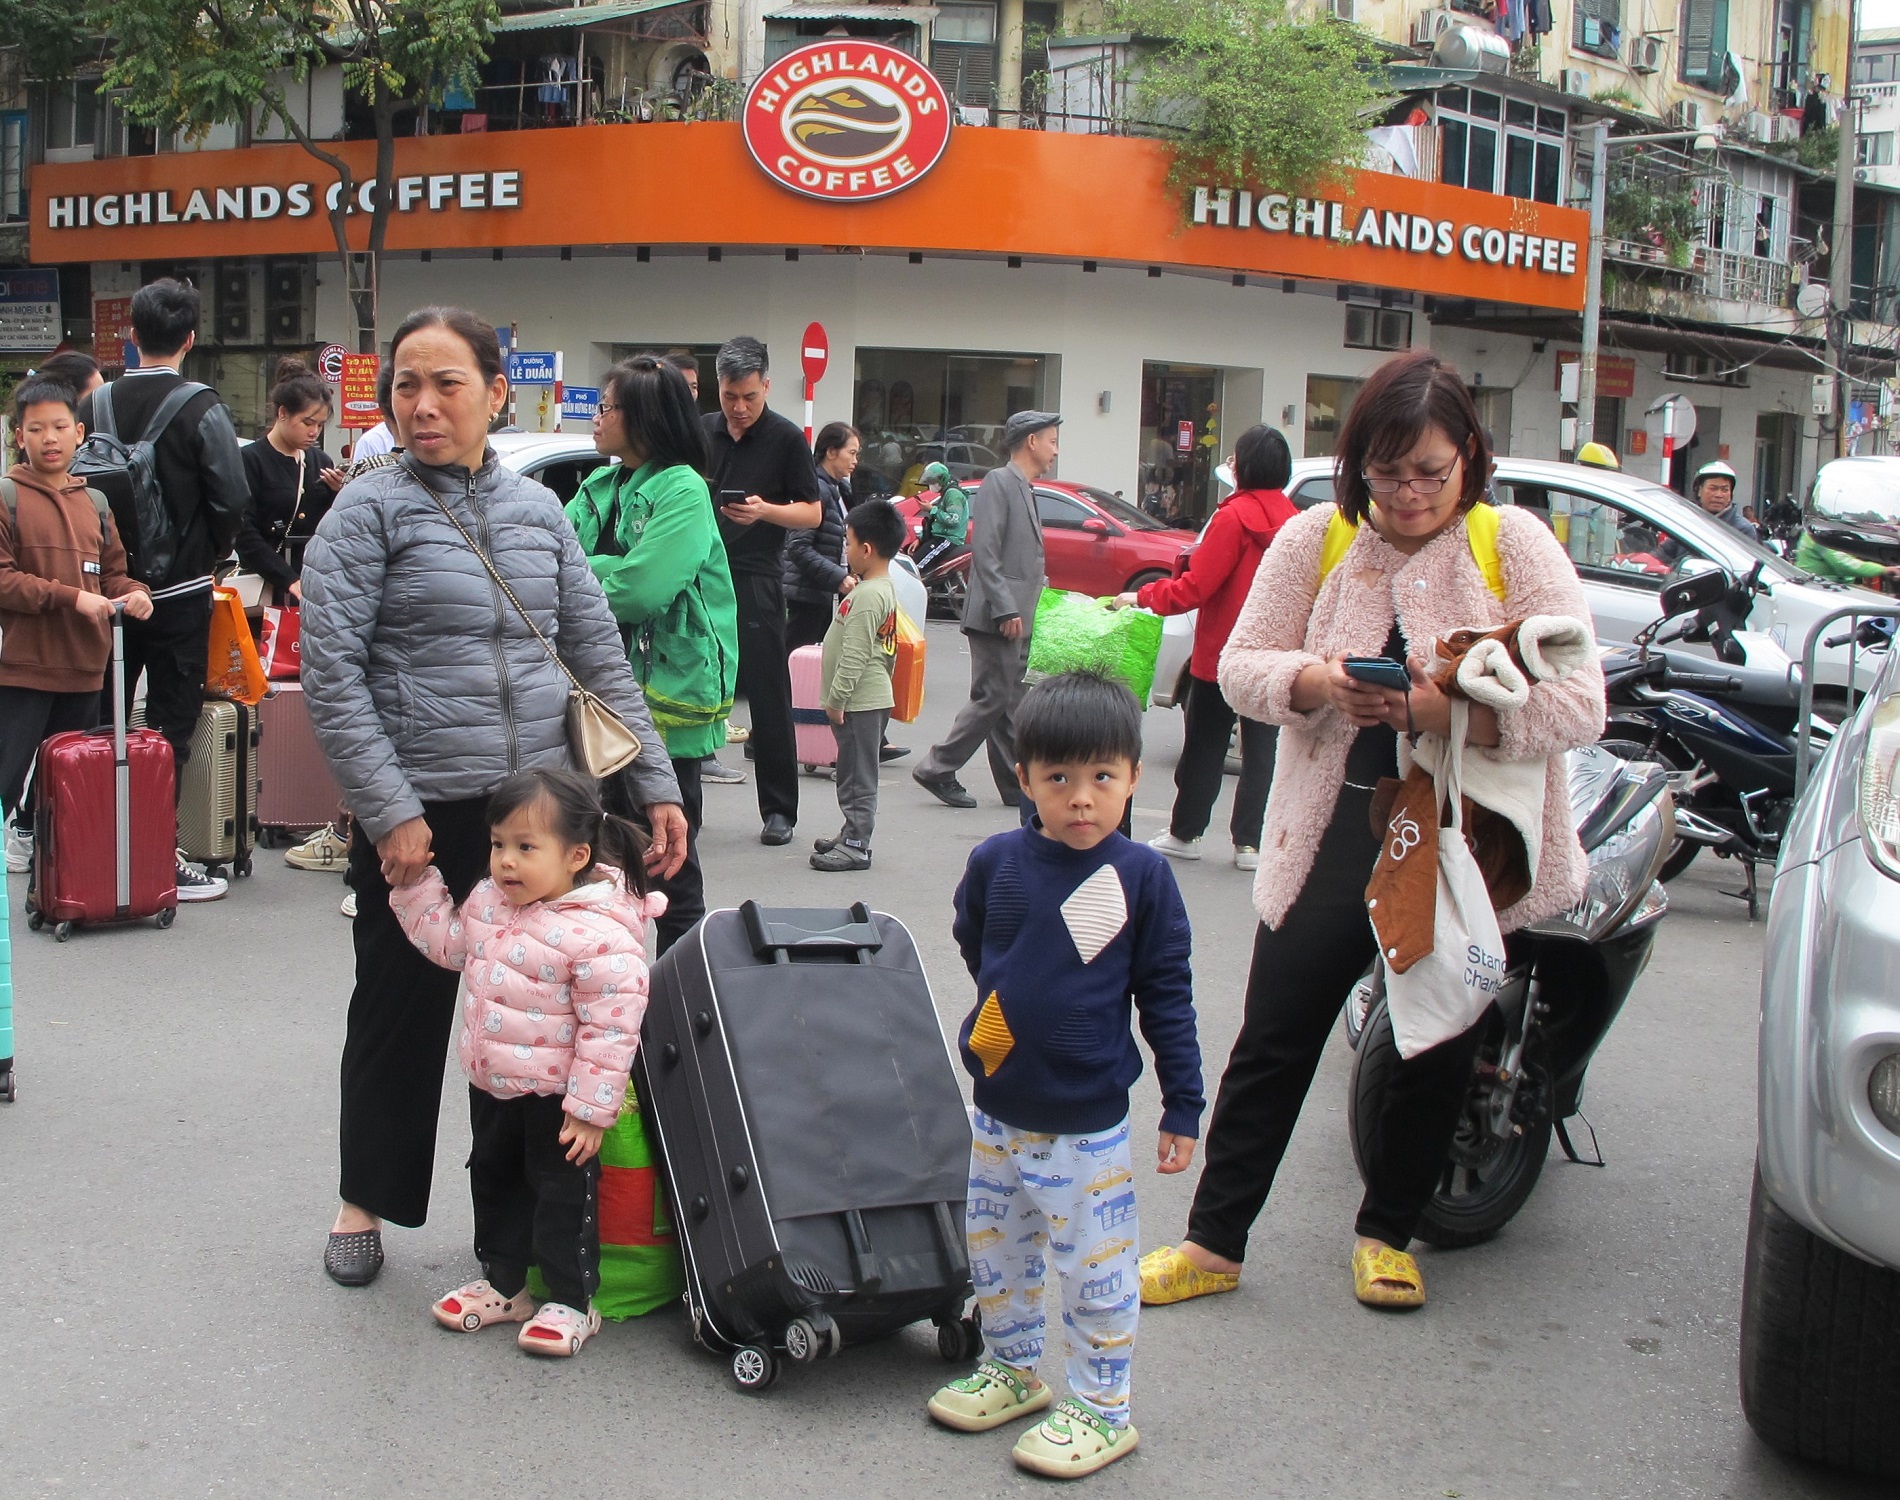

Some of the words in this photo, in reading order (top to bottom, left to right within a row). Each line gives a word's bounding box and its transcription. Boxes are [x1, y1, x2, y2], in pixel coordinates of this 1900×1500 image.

[756, 51, 939, 115] HIGHLANDS
[777, 153, 917, 192] COFFEE
[48, 182, 311, 229] HIGHLANDS
[1193, 186, 1455, 257] HIGHLANDS
[1462, 223, 1577, 275] COFFEE
[511, 366, 523, 379] LÊ
[525, 364, 553, 379] DUẨN
[575, 392, 588, 400] PHỐ
[526, 988, 552, 1000] rabbit
[598, 1052, 625, 1062] rabbit
